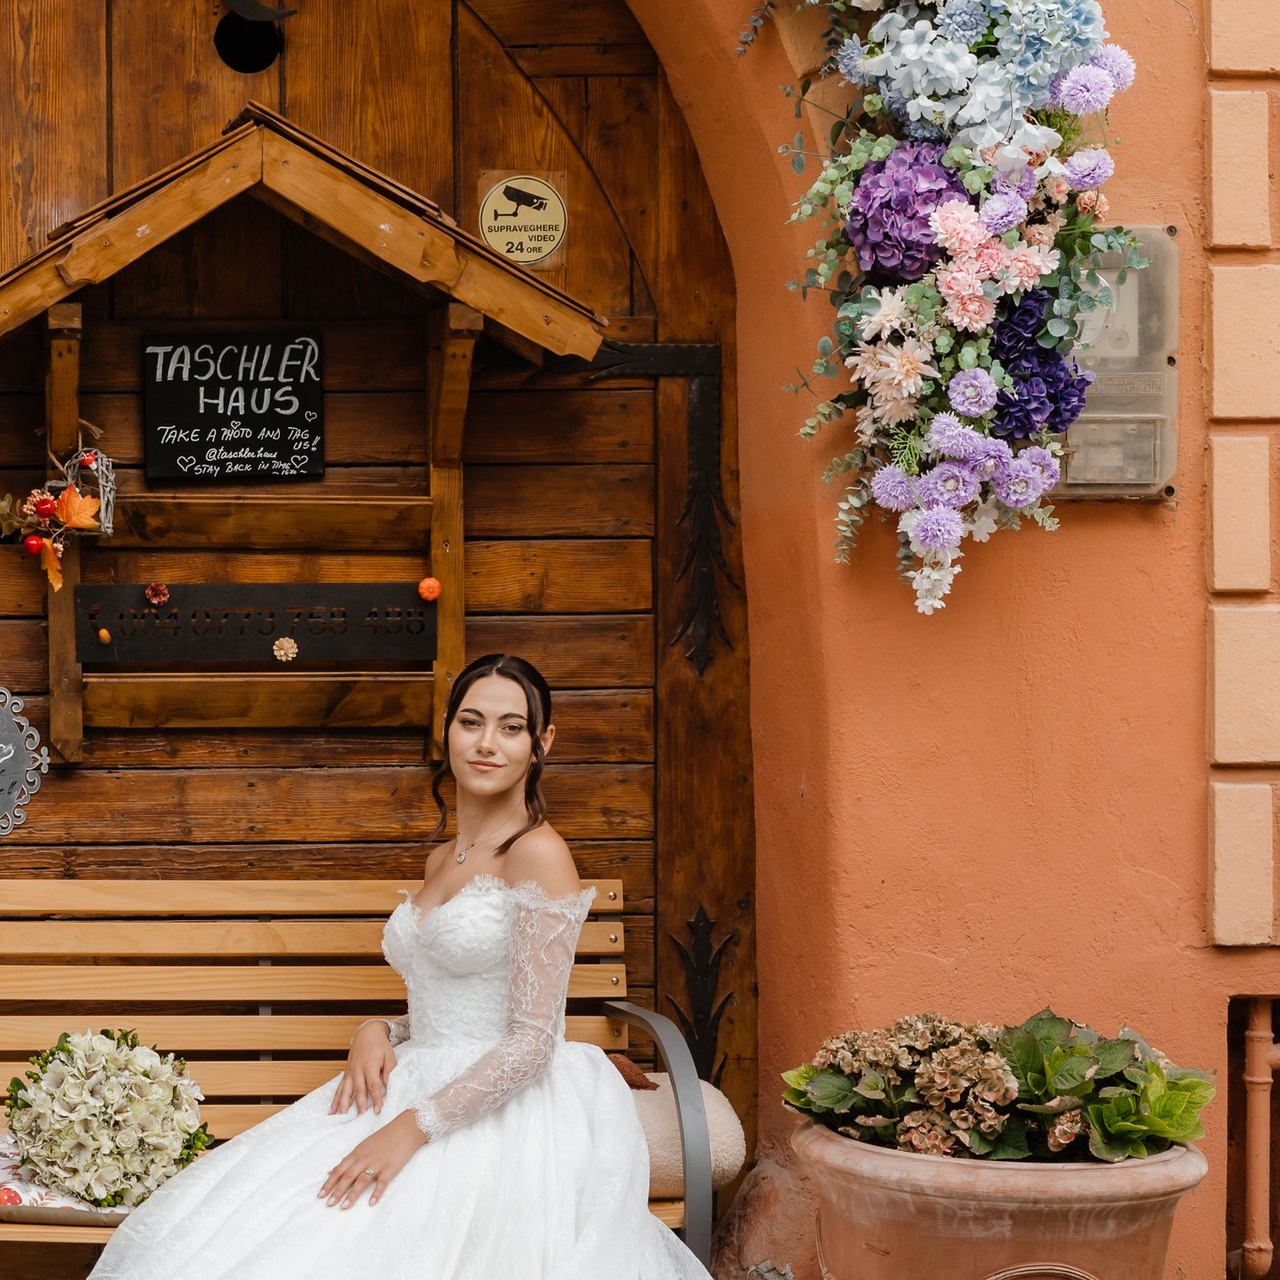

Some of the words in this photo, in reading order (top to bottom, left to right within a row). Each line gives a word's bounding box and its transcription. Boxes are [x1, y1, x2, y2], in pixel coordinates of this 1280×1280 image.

[487, 224, 560, 233] SUPRAVEGHERE
[527, 234, 556, 242] VIDEO
[505, 241, 525, 253] 24
[145, 337, 320, 383] TASCHLER
[198, 385, 300, 415] HAUS
[157, 425, 200, 444] TAKE
[206, 428, 217, 442] A
[221, 427, 253, 441] PHOTO
[257, 427, 281, 441] AND
[287, 426, 310, 440] TAG
[193, 464, 221, 477] STAY
[225, 461, 252, 473] BACK
[118, 607, 182, 637] 004
[191, 607, 276, 637] 0773
